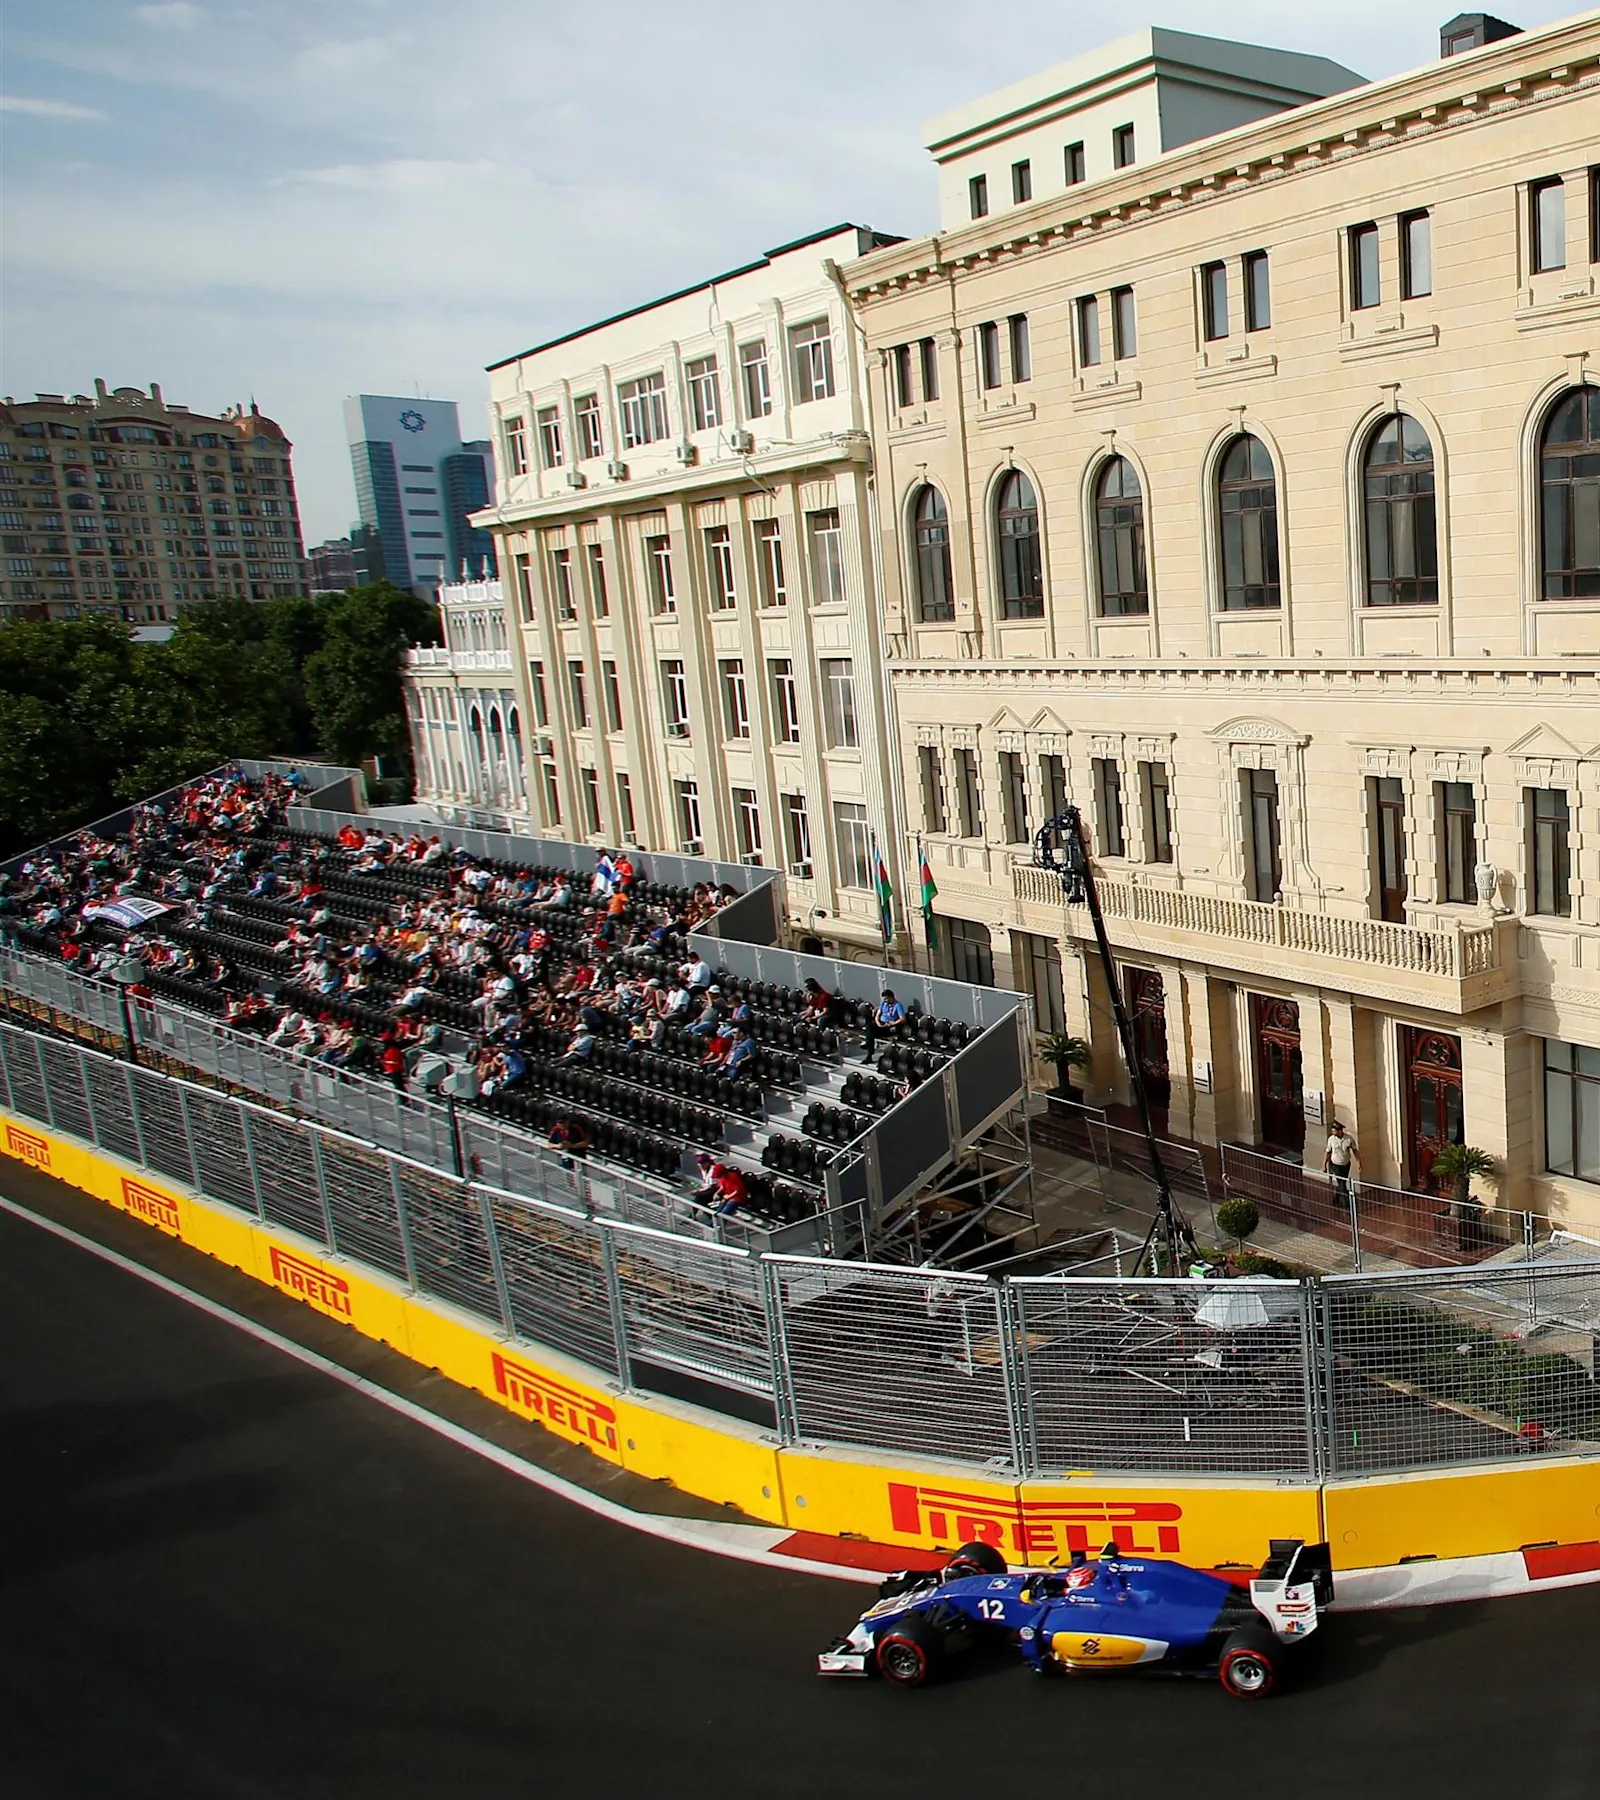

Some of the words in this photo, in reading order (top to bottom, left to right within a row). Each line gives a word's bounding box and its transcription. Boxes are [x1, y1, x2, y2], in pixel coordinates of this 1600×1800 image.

[6, 1124, 51, 1168] PIRELLI
[121, 1177, 180, 1230] PIRELLI
[269, 1246, 351, 1316] PIRELLI
[491, 1352, 617, 1451] PIRELLI
[888, 1482, 1183, 1553] PIRELLI
[977, 1598, 1006, 1620] 12
